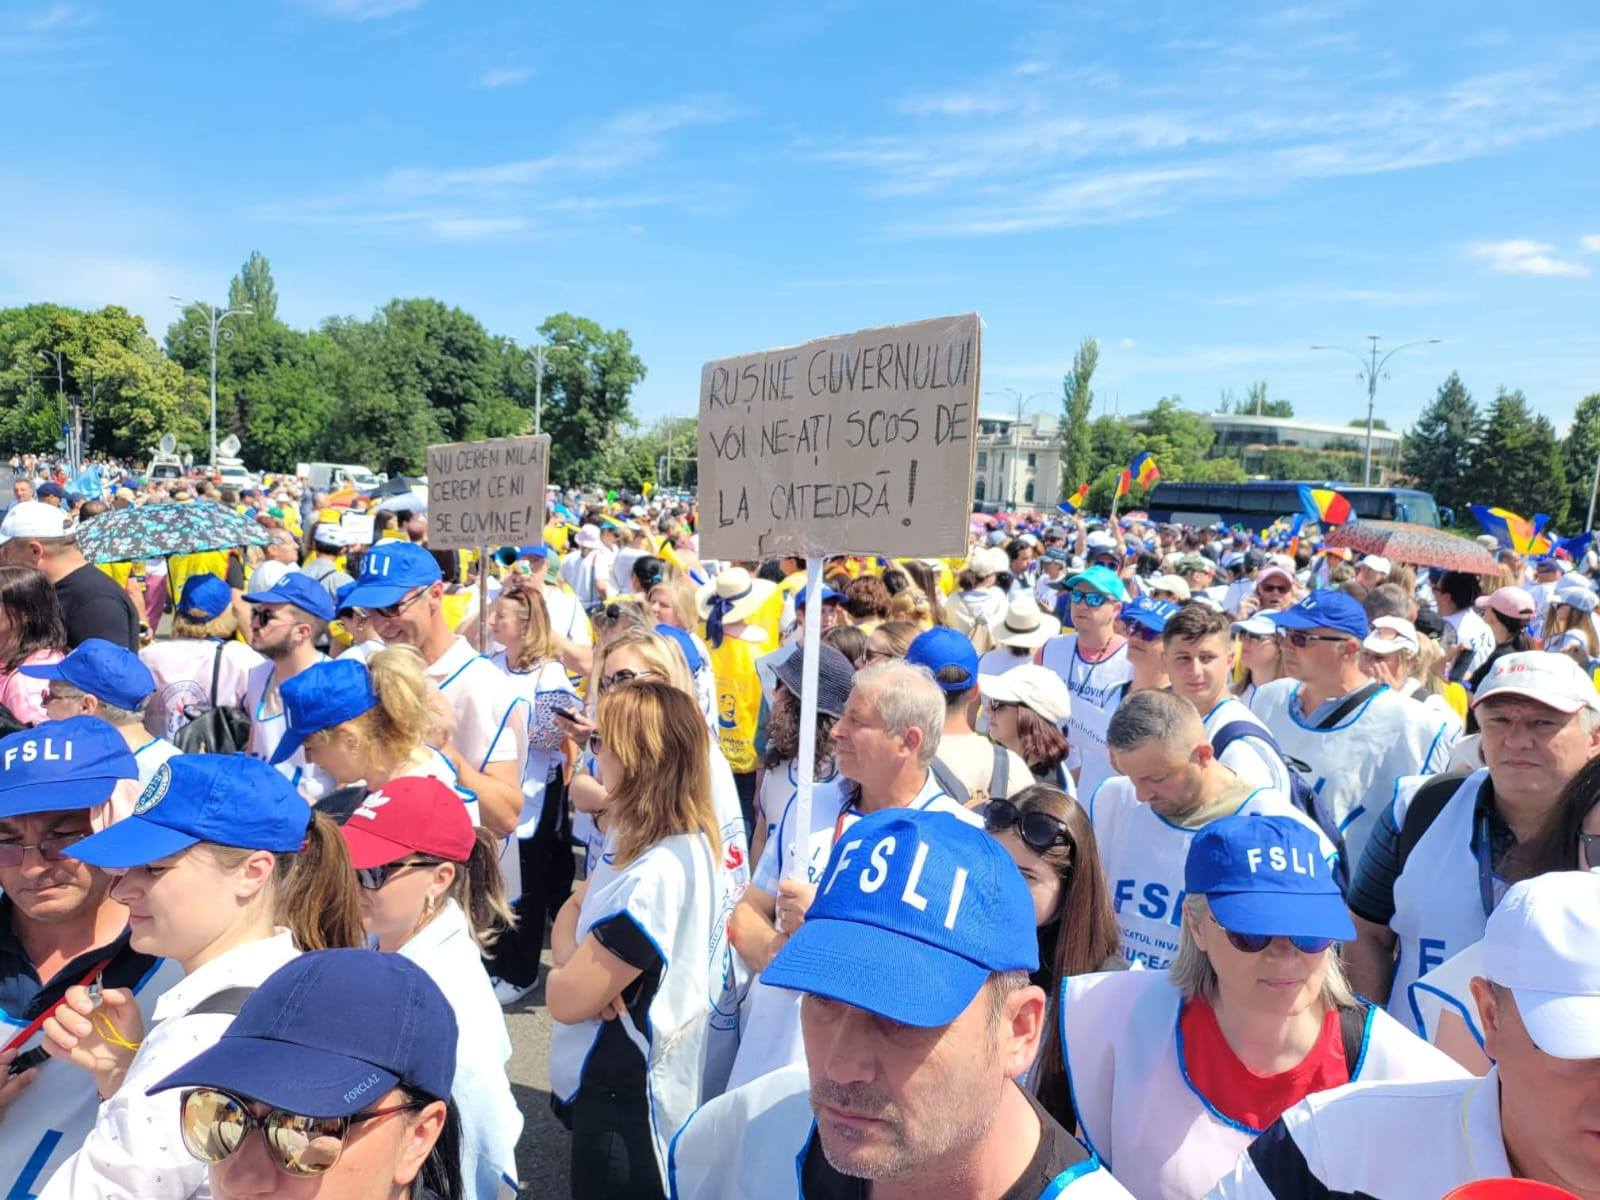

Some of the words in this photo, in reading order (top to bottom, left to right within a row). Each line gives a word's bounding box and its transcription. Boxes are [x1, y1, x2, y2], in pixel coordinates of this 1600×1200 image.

[709, 356, 798, 414] RUȘINE
[807, 338, 972, 397] GUVERNULUI
[709, 425, 746, 461] VOI
[846, 408, 919, 449] SCOS
[934, 402, 968, 447] DE
[431, 453, 453, 474] NU
[456, 448, 500, 473] CEREM
[431, 478, 480, 502] CEREM
[488, 475, 507, 498] CE
[510, 476, 525, 496] NI
[435, 513, 453, 532] SE
[718, 486, 750, 528] LA
[5, 738, 73, 771] FSLI
[1246, 846, 1315, 878] FSLI
[823, 836, 969, 930] FSLI
[343, 1073, 380, 1104] FORCLAZ
